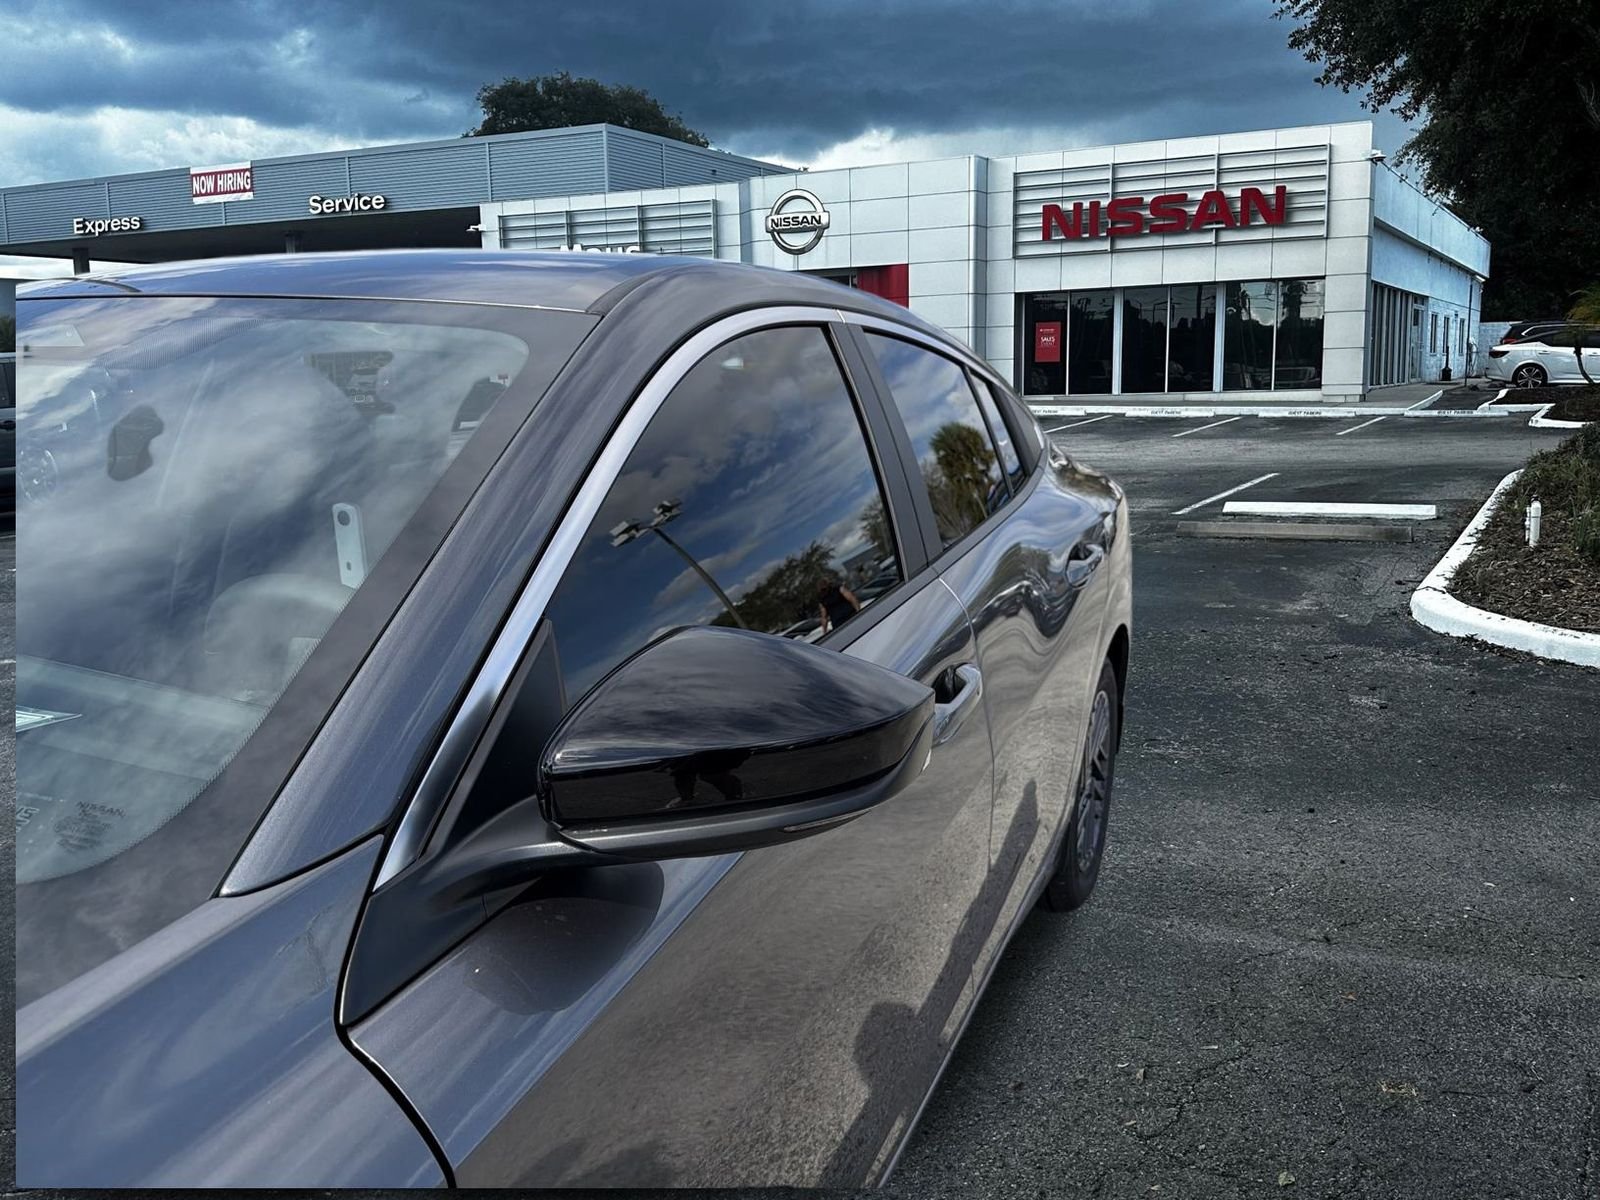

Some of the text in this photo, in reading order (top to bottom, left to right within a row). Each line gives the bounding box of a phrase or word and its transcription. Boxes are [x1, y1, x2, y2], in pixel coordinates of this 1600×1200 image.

[192, 171, 251, 195] NOW HIRING
[309, 193, 385, 214] Service
[1042, 185, 1287, 241] NISSAN
[73, 217, 141, 236] Express
[770, 215, 822, 228] NISSAN
